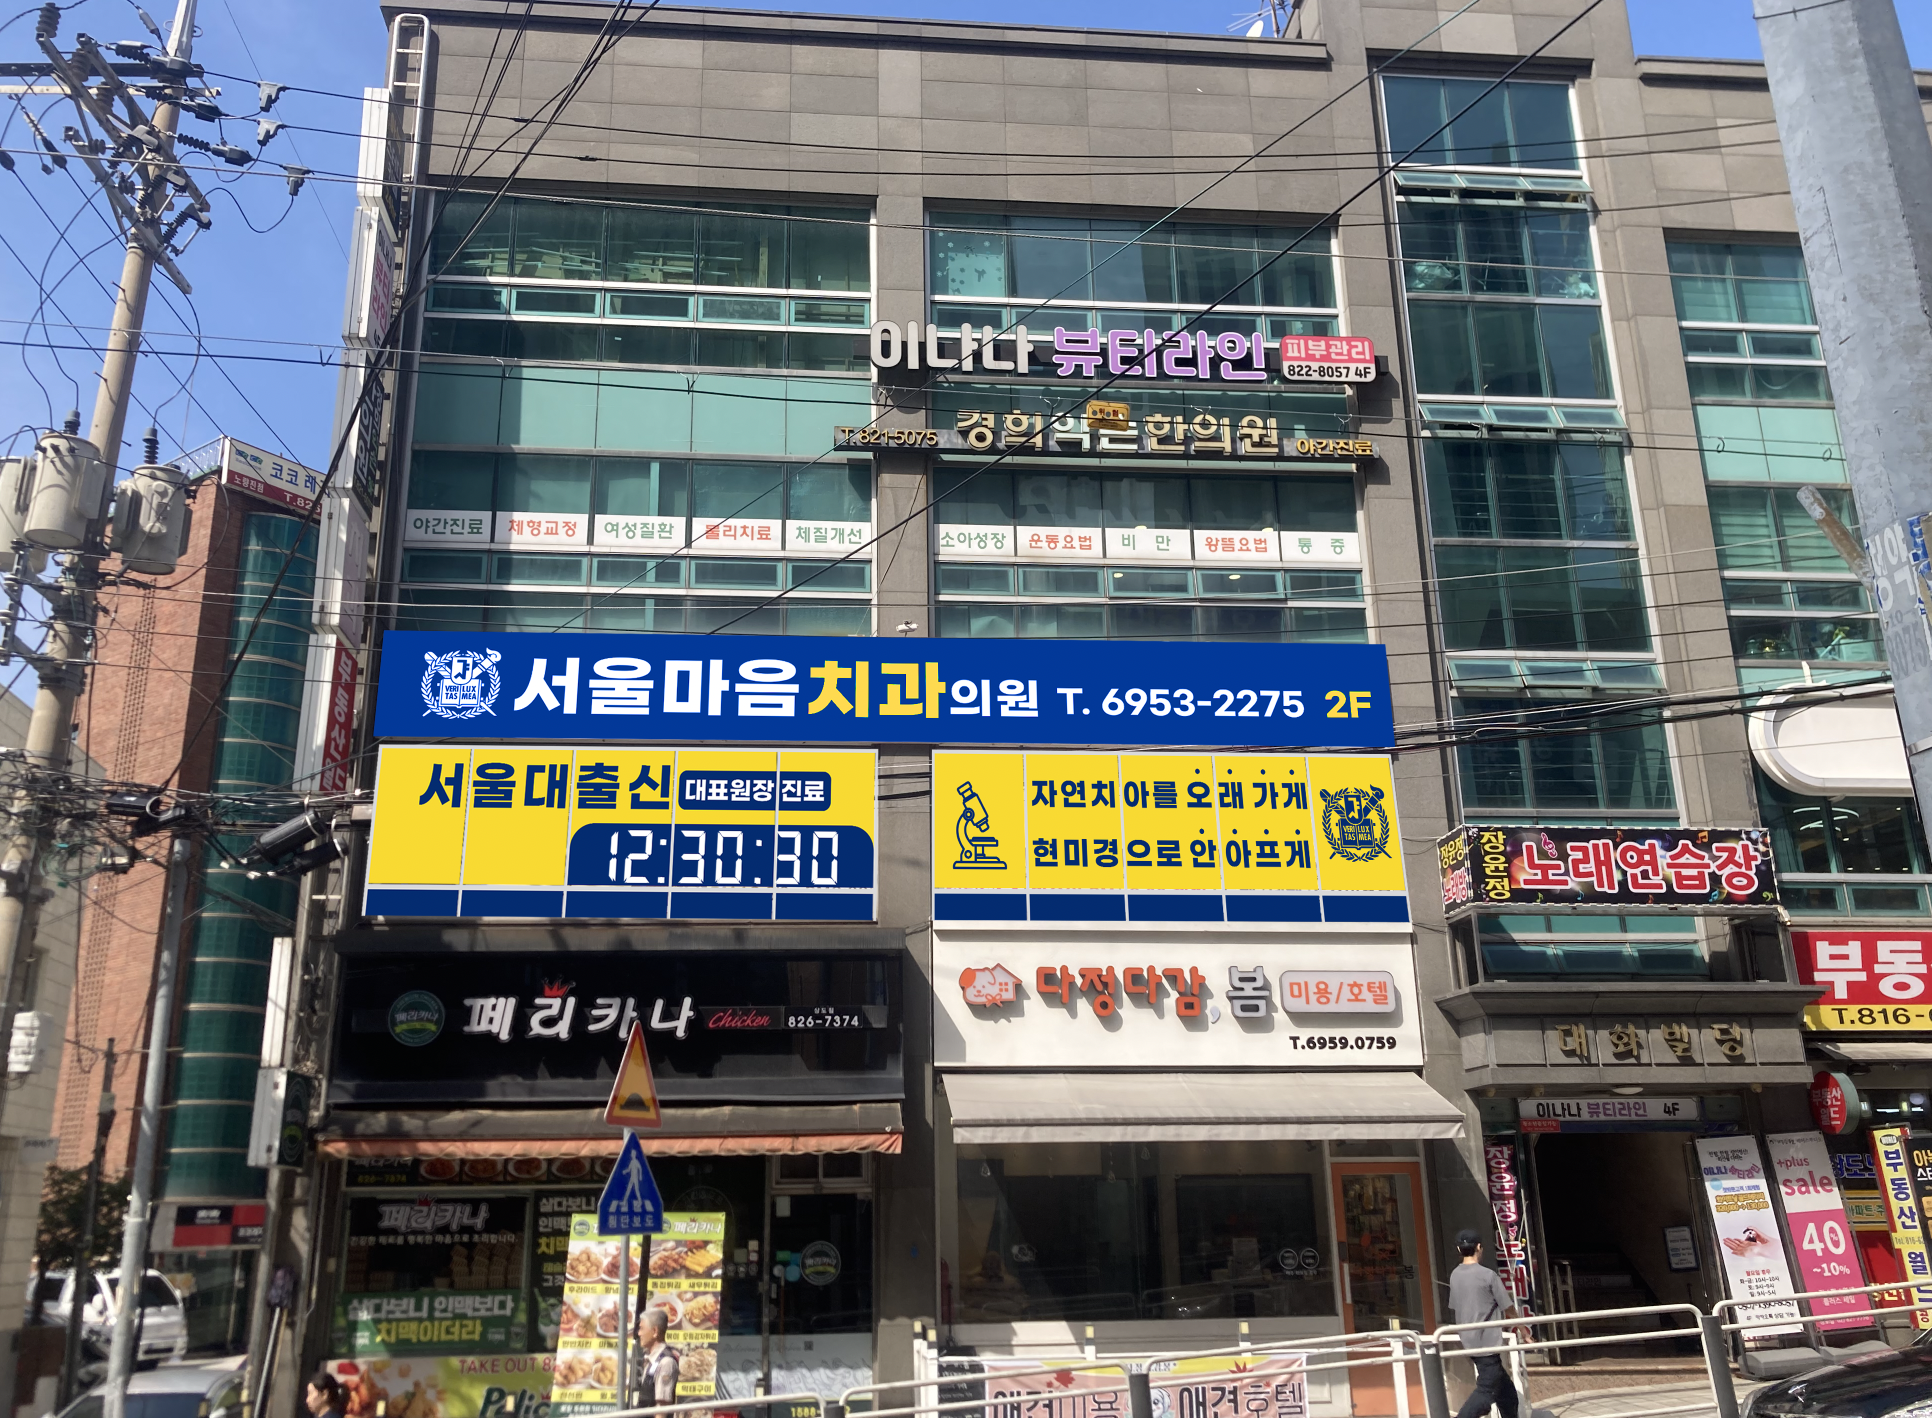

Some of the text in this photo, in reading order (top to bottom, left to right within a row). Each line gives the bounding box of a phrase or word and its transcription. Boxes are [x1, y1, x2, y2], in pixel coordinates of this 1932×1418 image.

[870, 320, 1268, 380] 이나나 뷰티라인
[1285, 338, 1371, 361] 피부관리
[1287, 364, 1372, 379] 822-8057 4F
[1296, 438, 1375, 456] 야간진료
[270, 462, 324, 498] 코코레
[413, 516, 484, 536] 야간진료
[507, 519, 578, 538] 체형교정
[603, 521, 674, 540] 여성질환
[704, 522, 772, 542] 물리치료
[795, 525, 863, 545] 체질개선
[940, 531, 1007, 550] 소아성장
[1028, 533, 1093, 551] 운동요법
[1204, 536, 1268, 553] 왕뜸요법
[444, 692, 477, 700] TAS MEA
[462, 685, 477, 693] LUX
[1057, 687, 1091, 716] T.
[1101, 687, 1306, 719] 6953-2275
[1324, 690, 1372, 719] 2F
[418, 762, 672, 810] 서울대출신
[1031, 779, 1309, 811] 자연치아를 오래 가게
[607, 829, 839, 885] 12:30:30
[1031, 837, 1183, 868] 현미경으로
[1440, 834, 1465, 869] 장윤정
[1479, 830, 1512, 900] 장윤정
[1521, 838, 1760, 895] 노래연습장
[1813, 940, 1932, 1000] 부동
[1226, 965, 1271, 1019] 봄
[1288, 978, 1390, 1006] 미용/호텔
[462, 994, 695, 1041] 페리카나
[708, 1008, 773, 1029] Chicken
[787, 1015, 860, 1029] 826-7374
[1831, 1007, 1932, 1026] T.816-
[1289, 1035, 1397, 1051] T.6959.0759
[1554, 1021, 1743, 1058] 대화빌딩
[1536, 1101, 1681, 1119] 이나나 뷰티라인 4F
[1703, 1163, 1762, 1180] 이나나 뷰티라인
[1485, 1145, 1518, 1224] 장윤정
[1782, 1171, 1834, 1197] sale
[1883, 1148, 1919, 1230] 부동산
[377, 1202, 491, 1232] 페리카나
[538, 1216, 571, 1234] 인맥
[607, 1214, 655, 1229] 횡단보도
[673, 1220, 723, 1235] 페리카나
[375, 1318, 484, 1344] 치맥이더라
[459, 1358, 500, 1375] TAKE
[504, 1357, 538, 1374] OUT
